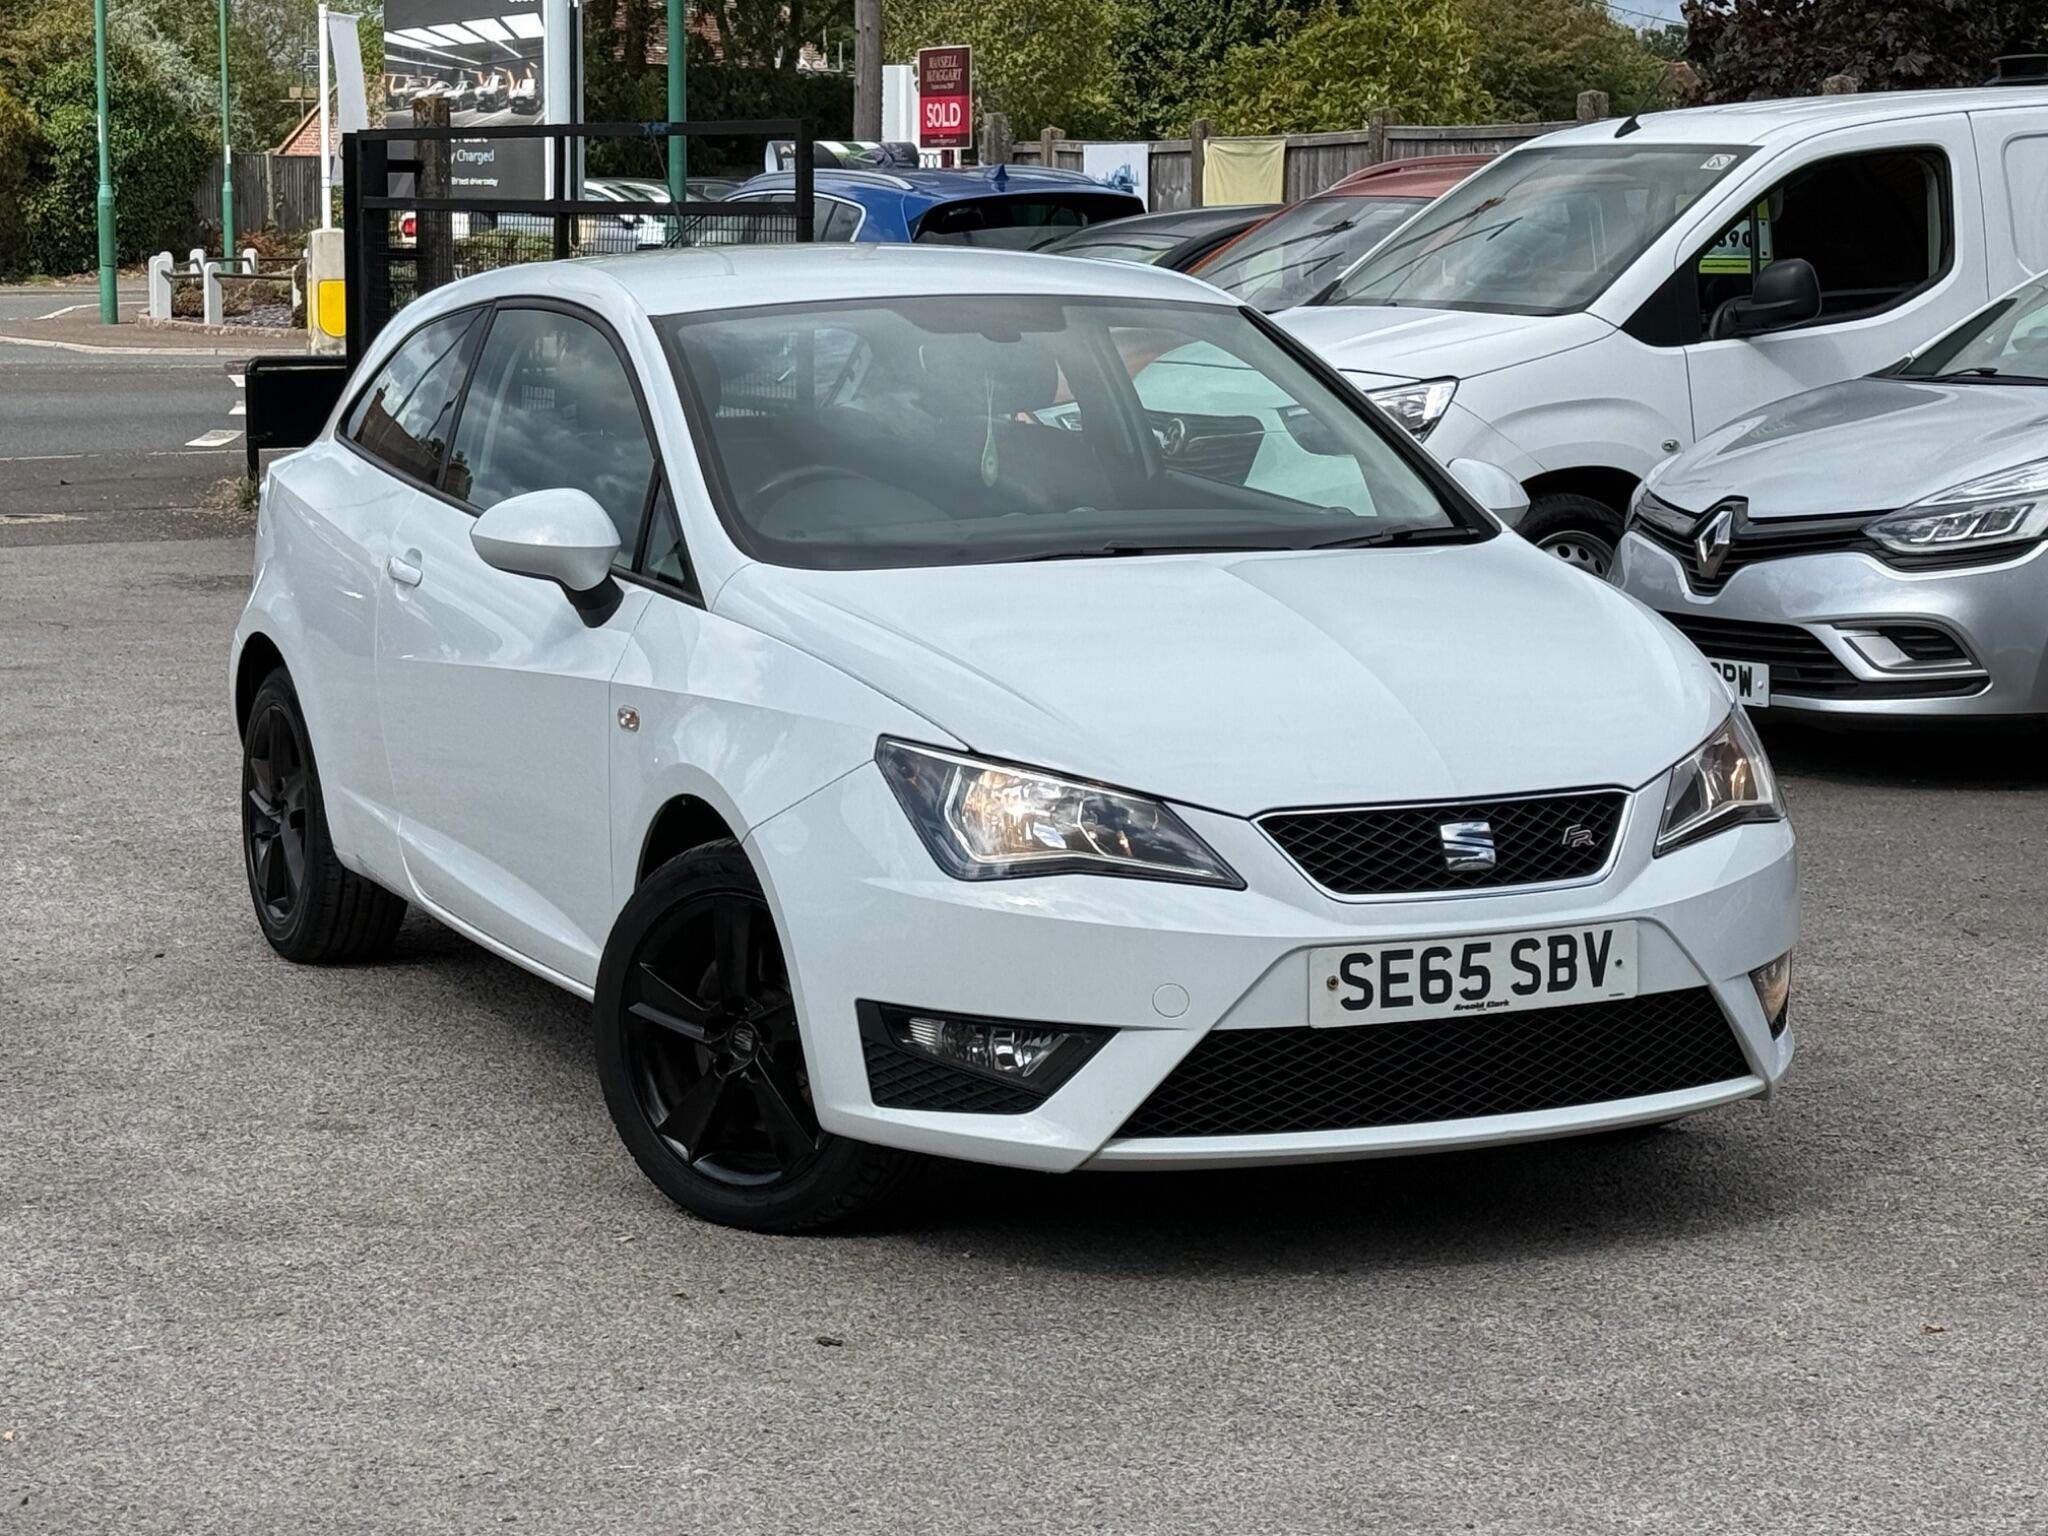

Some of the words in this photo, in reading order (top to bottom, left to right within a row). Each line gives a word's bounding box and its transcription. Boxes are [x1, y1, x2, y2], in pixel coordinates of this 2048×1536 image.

[926, 102, 961, 128] SOLD
[457, 149, 495, 165] Charged
[1710, 661, 1753, 698] PW
[1340, 941, 1491, 1011] SE65
[1510, 929, 1613, 996] SBV
